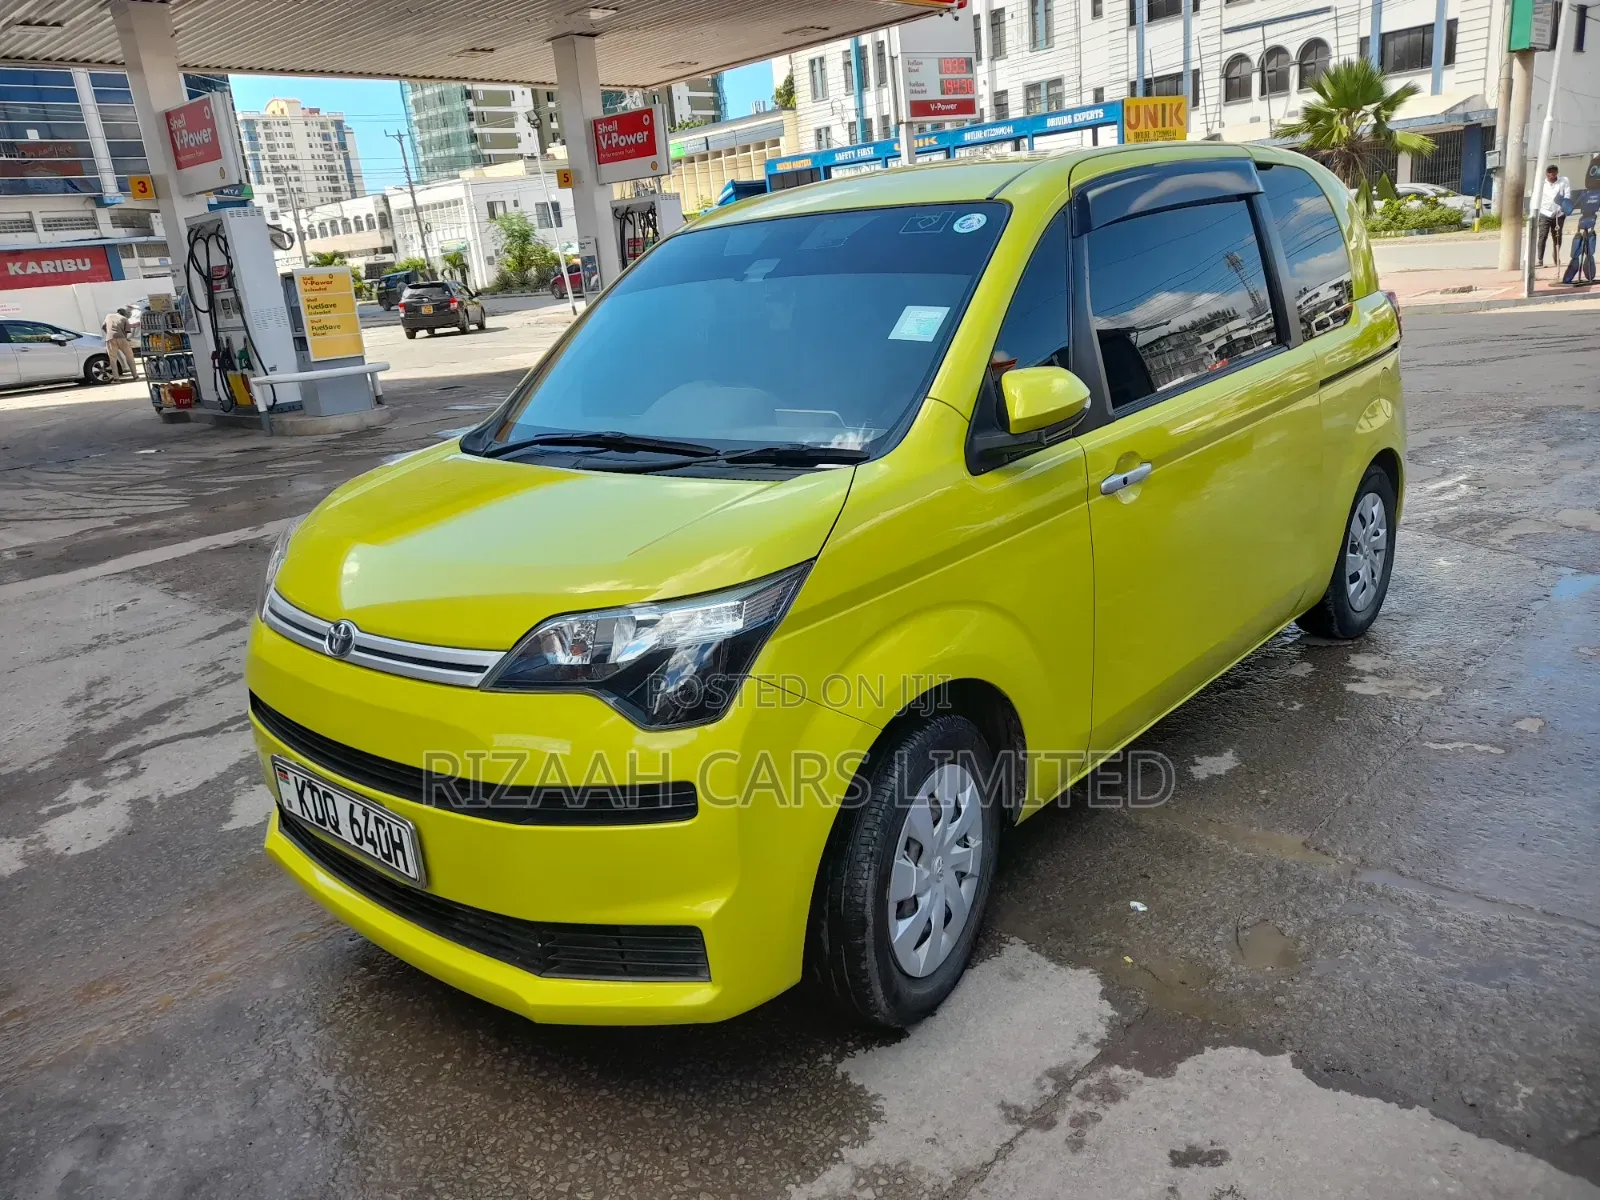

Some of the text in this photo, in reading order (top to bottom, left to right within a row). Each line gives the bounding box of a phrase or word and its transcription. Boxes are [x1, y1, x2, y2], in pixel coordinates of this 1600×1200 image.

[930, 102, 958, 111] V-Power
[169, 112, 187, 131] Shell
[1046, 108, 1104, 127] DRIVING EXPERTS
[1126, 102, 1185, 130] UNIK
[598, 120, 618, 134] Shell
[172, 127, 212, 150] V-Power
[600, 130, 649, 150] V-Power
[835, 146, 875, 161] SAFETY FIRST
[563, 173, 570, 183] 5
[137, 181, 148, 194] 3
[7, 258, 92, 275] KARIBU
[294, 776, 410, 874] KDQ 640H
